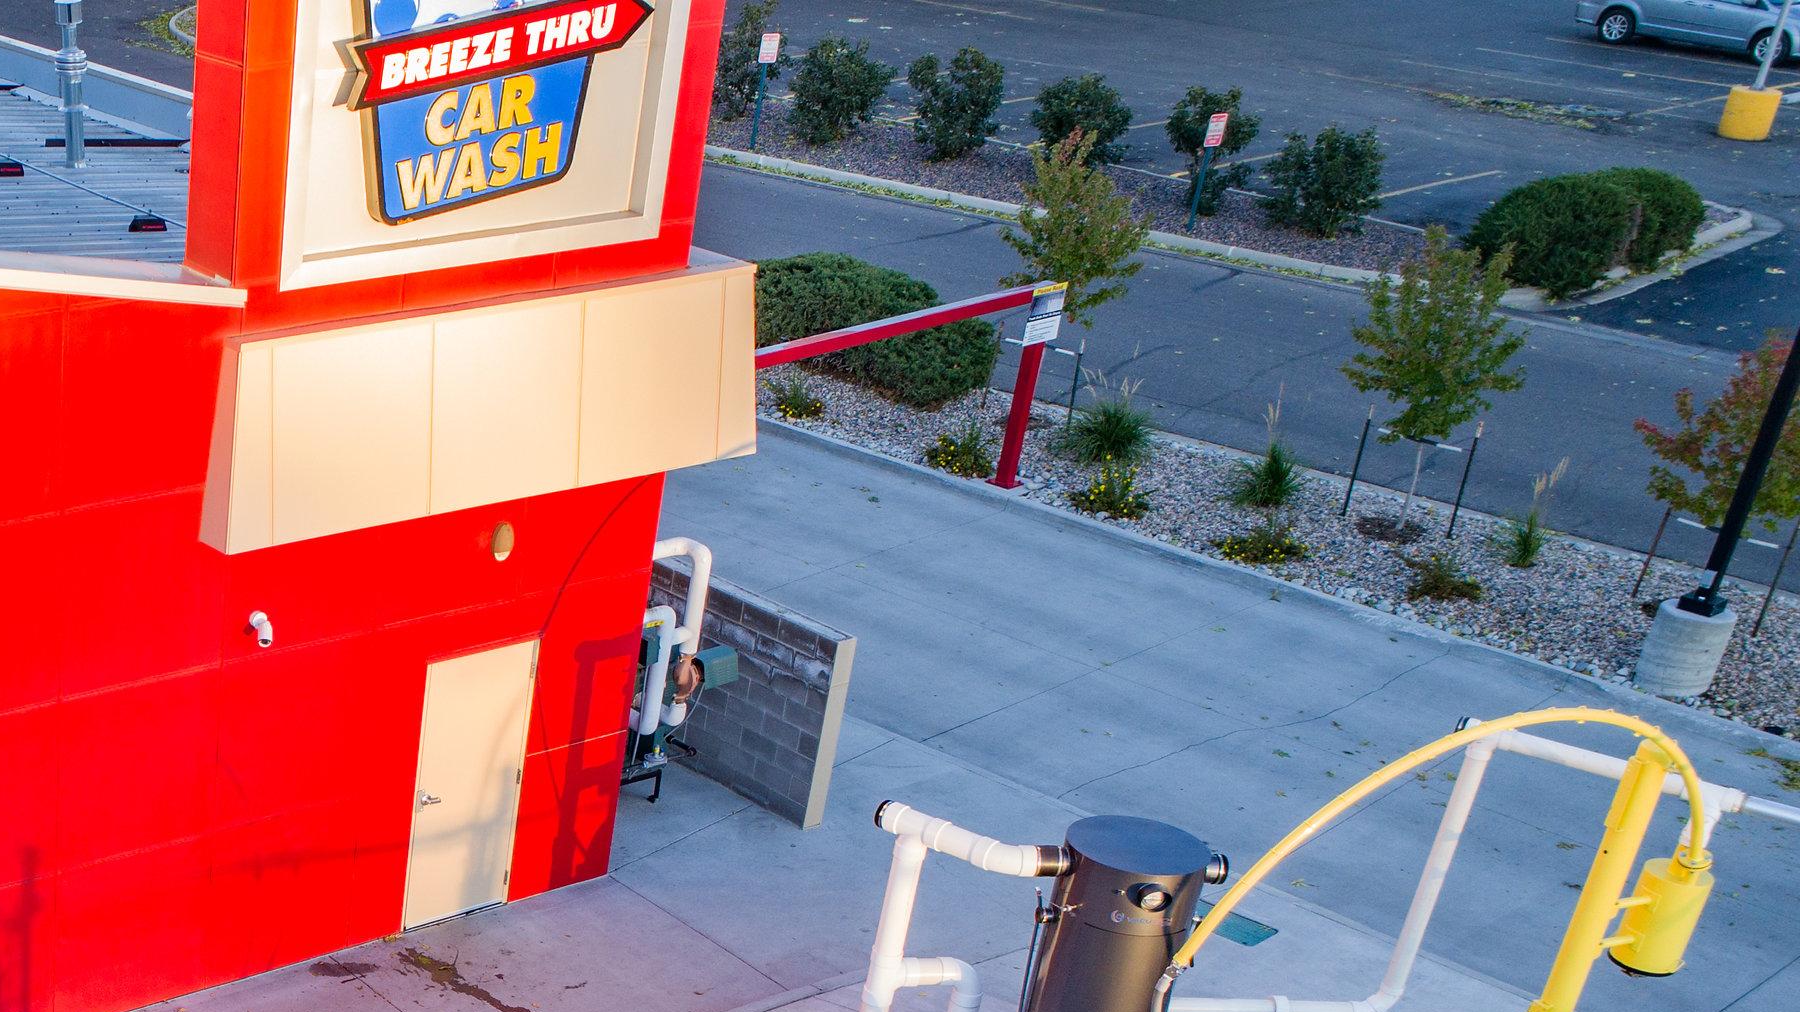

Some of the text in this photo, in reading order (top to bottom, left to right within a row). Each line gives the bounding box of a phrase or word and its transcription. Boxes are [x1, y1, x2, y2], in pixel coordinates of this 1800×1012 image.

[380, 4, 617, 90] BREEZE THRU
[424, 73, 535, 146] CAR
[395, 121, 562, 210] WASH
